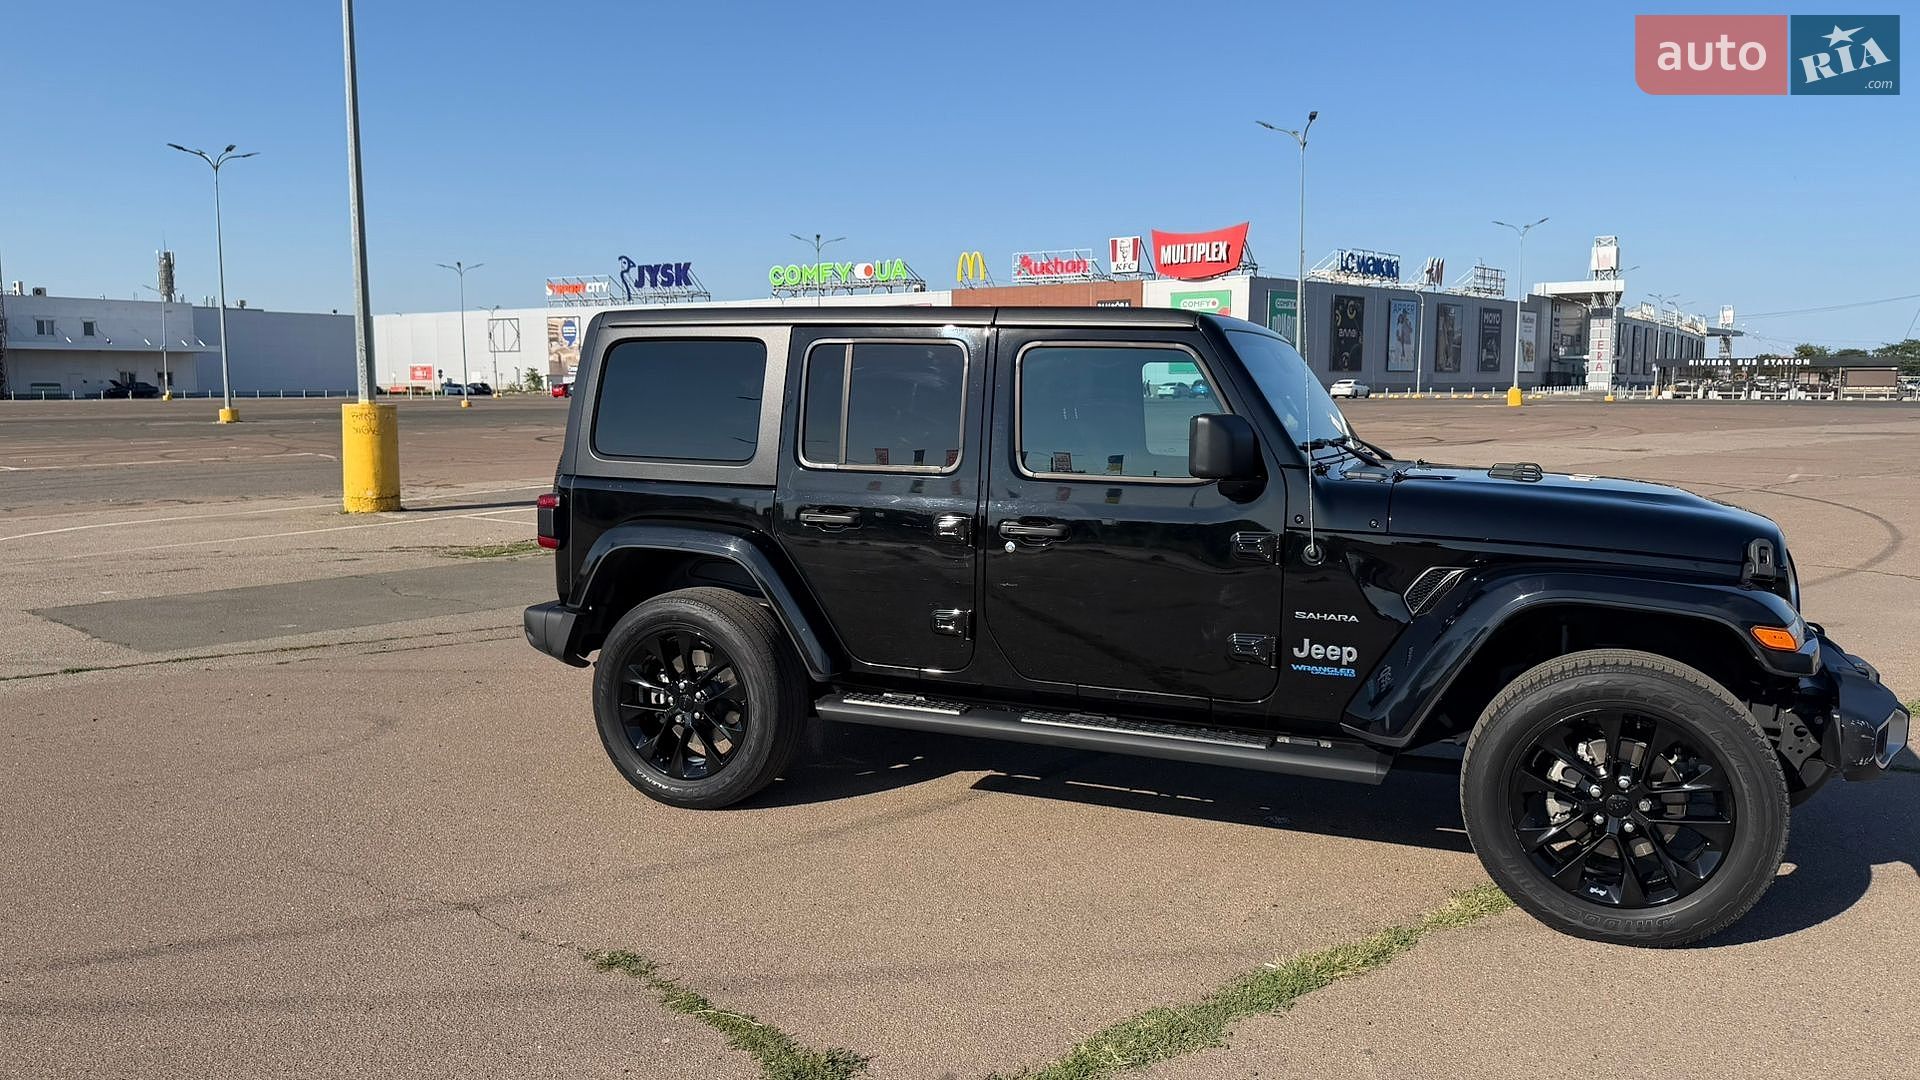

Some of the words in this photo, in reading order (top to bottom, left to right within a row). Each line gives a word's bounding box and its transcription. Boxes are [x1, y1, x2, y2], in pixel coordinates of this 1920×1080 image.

[1161, 240, 1230, 266] MULTIPLEX
[1017, 255, 1089, 276] Auchan
[1115, 262, 1135, 271] KFC
[634, 262, 693, 289] JYSK
[1182, 299, 1211, 308] COMFY
[1763, 358, 1811, 366] STATION
[1294, 611, 1360, 623] SAHARA
[1293, 638, 1358, 665] Jeep
[1290, 663, 1356, 675] WRANGLER
